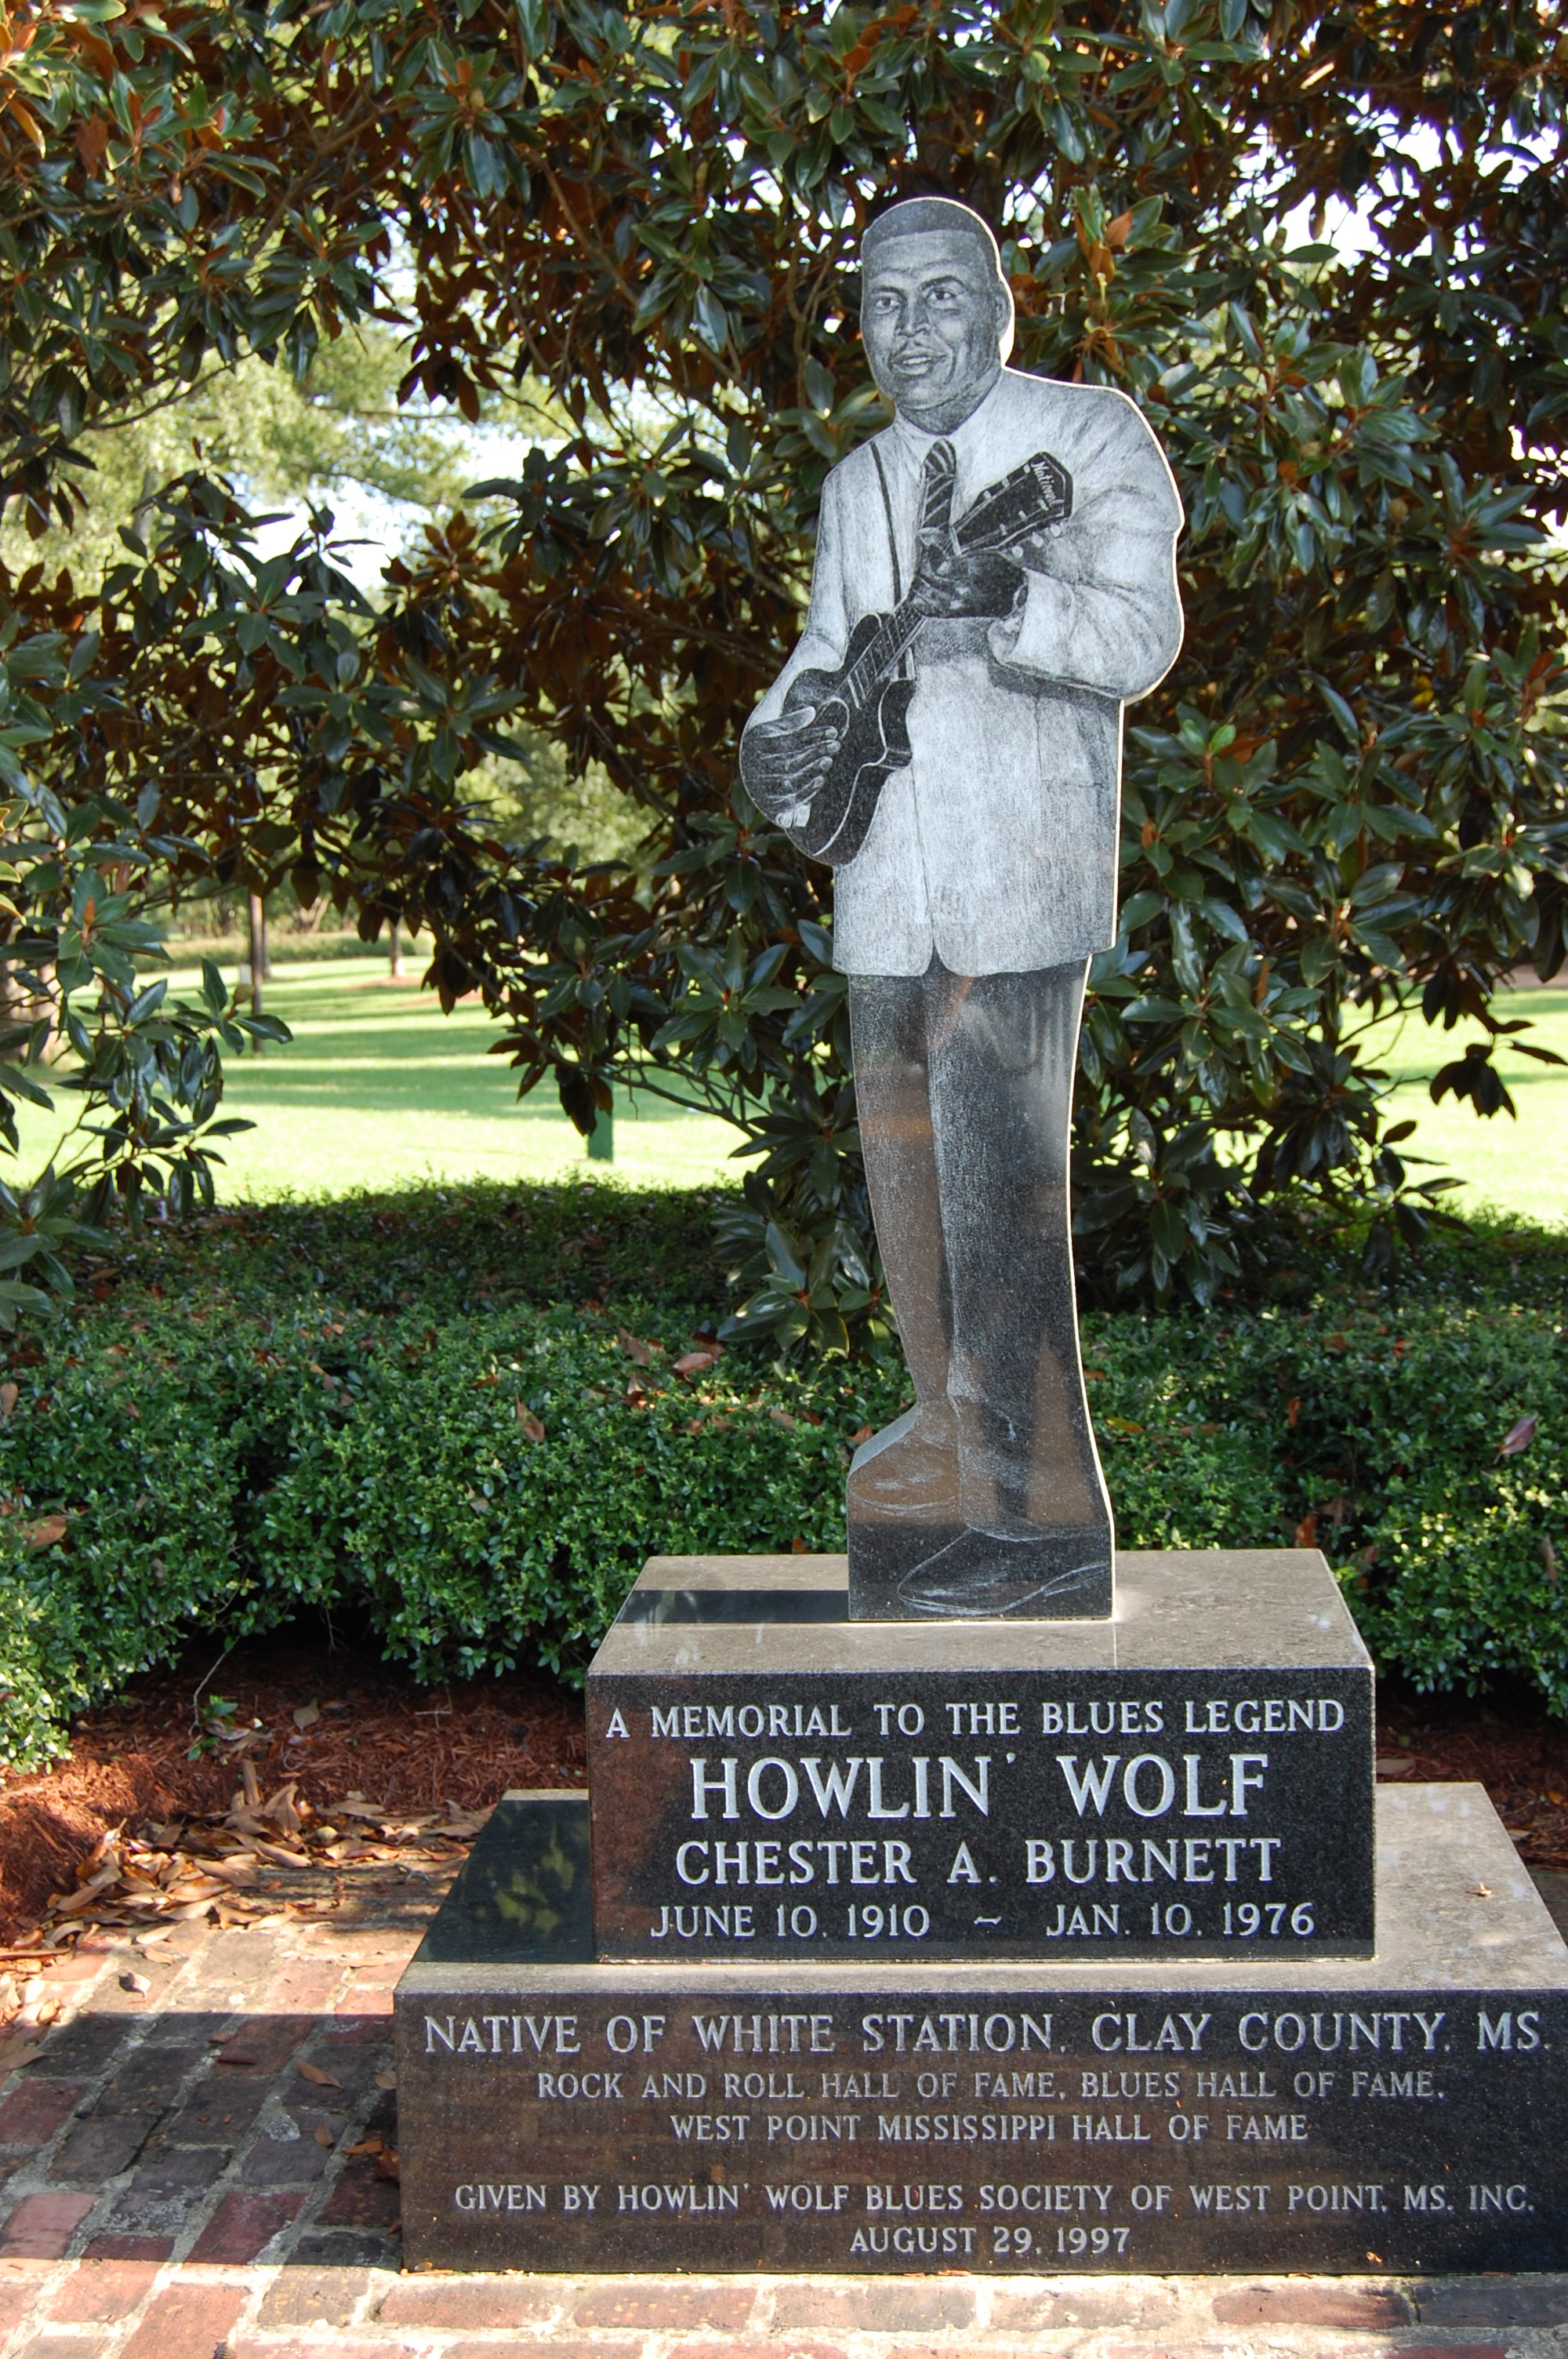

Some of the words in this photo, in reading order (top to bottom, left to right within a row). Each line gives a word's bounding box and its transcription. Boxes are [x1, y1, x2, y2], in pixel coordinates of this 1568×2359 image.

[1030, 460, 1065, 508] National
[605, 1707, 630, 1738] A
[651, 1704, 851, 1738] MEMORIAL
[873, 1703, 925, 1736] TO
[946, 1703, 1021, 1735] THE
[1042, 1700, 1163, 1734] BLUES
[1185, 1699, 1344, 1733] LEGEND
[689, 1752, 1015, 1820] HOWLIN'
[1055, 1753, 1269, 1817] WOLF
[676, 1840, 917, 1885] CHESTER
[946, 1841, 996, 1884] A.
[1025, 1837, 1281, 1884] BURNETT
[650, 1906, 756, 1937] JUNE
[848, 1903, 930, 1938] 1910
[1046, 1904, 1130, 1936] JAN.
[1223, 1902, 1314, 1936] 1976
[423, 2015, 581, 2053] NATIVE
[606, 2015, 666, 2053] OF
[691, 2015, 833, 2052] WHITE
[1091, 2012, 1212, 2052] CLAY
[1476, 2011, 1550, 2050] MS.
[538, 2073, 624, 2099] ROCK
[641, 2073, 706, 2098] AND
[724, 2073, 804, 2099] ROLL
[821, 2072, 899, 2098] HALL
[916, 2072, 957, 2098] OF
[1081, 2071, 1181, 2098] BLUES
[1196, 2071, 1276, 2098] HALL
[1294, 2071, 1335, 2097] OF
[670, 2115, 750, 2140] WEST
[767, 2115, 861, 2141] POINT
[877, 2114, 1055, 2141] MISSISSIPPI
[1072, 2114, 1151, 2140] HALL
[1168, 2114, 1209, 2140] OF
[1226, 2114, 1308, 2140] FAME
[455, 2184, 546, 2210] GIVEN
[564, 2185, 601, 2210] BY
[618, 2183, 749, 2211] HOWLIN'
[764, 2185, 849, 2211] WOLF
[866, 2185, 963, 2211] BLUES
[979, 2184, 1113, 2212] SOCIETY
[1131, 2185, 1174, 2211] OF
[1189, 2185, 1271, 2211] WEST
[1403, 2185, 1454, 2211] MS.
[1468, 2183, 1534, 2211] INC.
[849, 2226, 977, 2253] AUGUST
[1057, 2226, 1131, 2254] 1997
